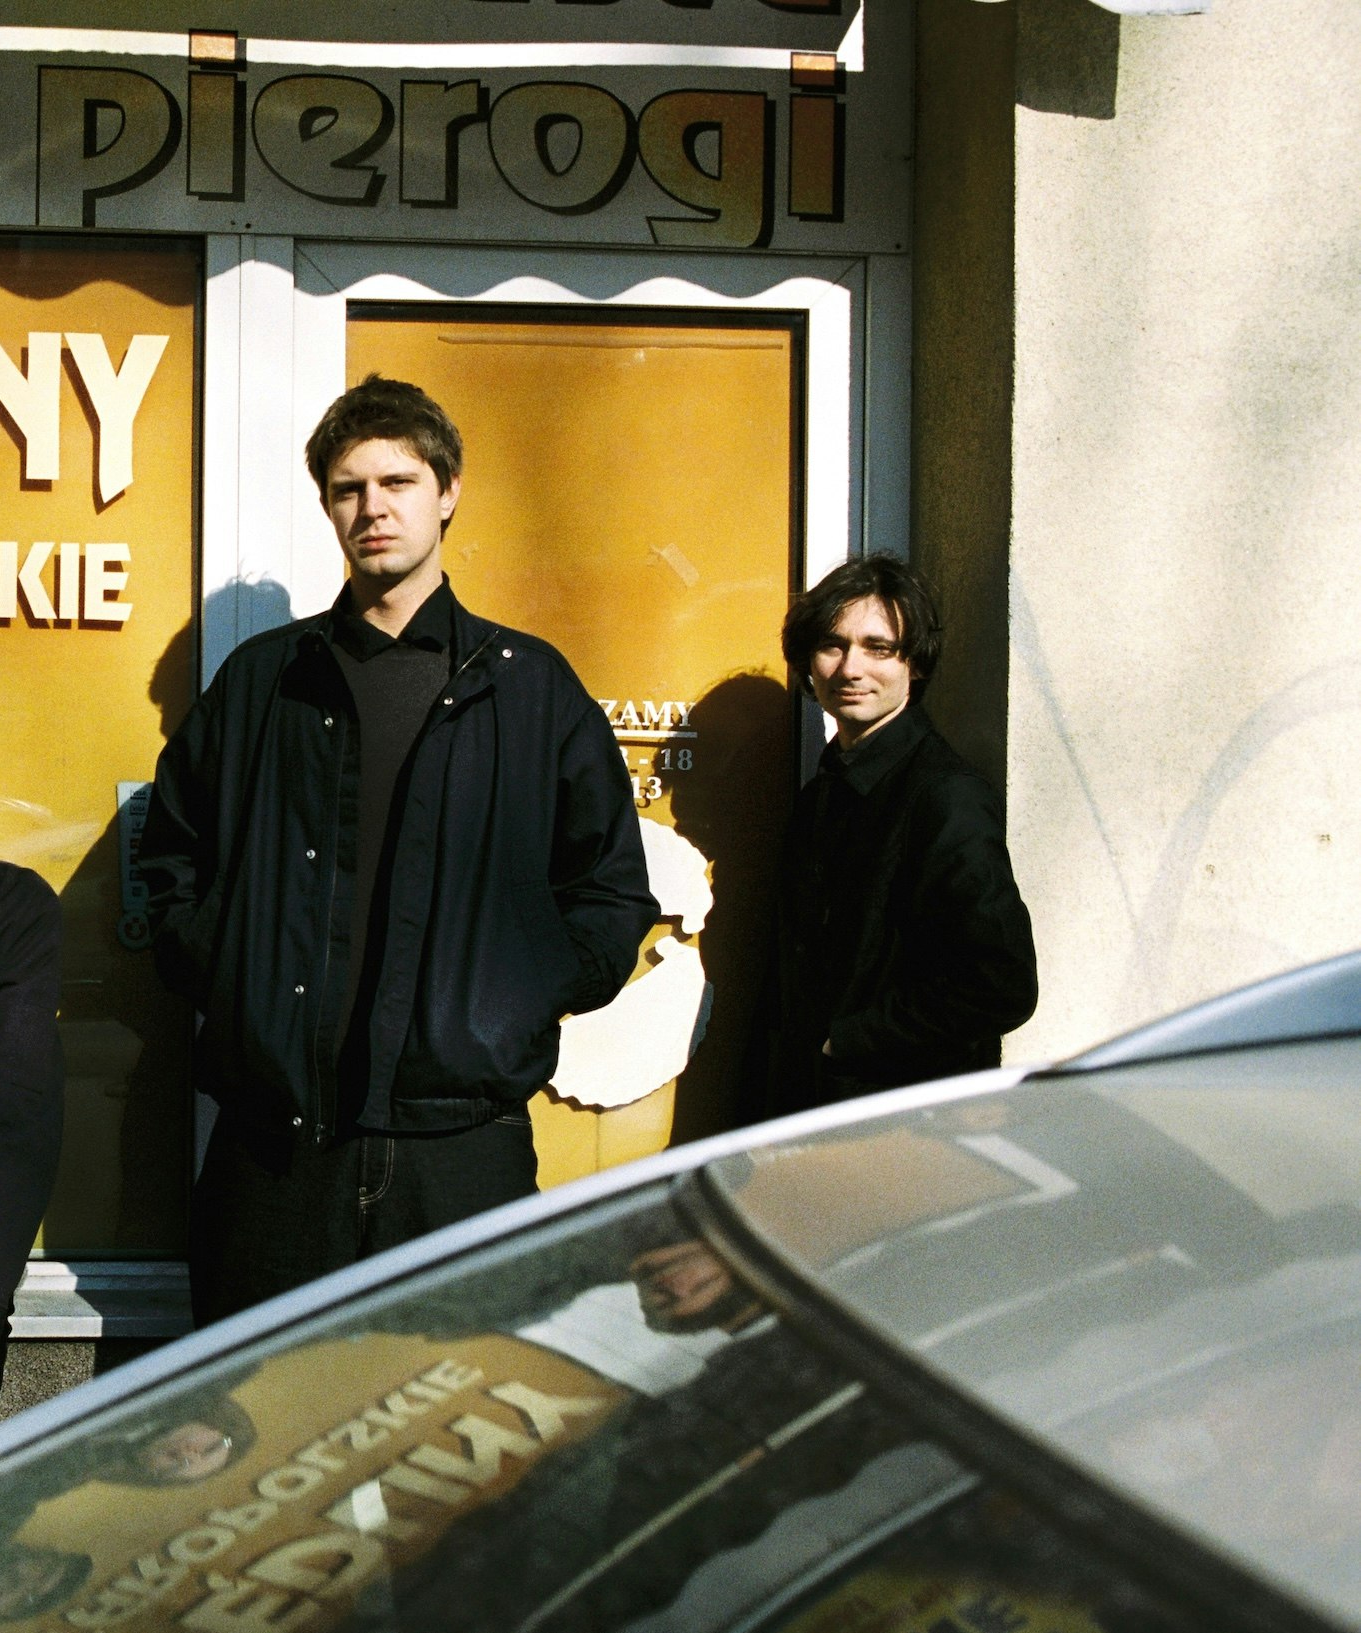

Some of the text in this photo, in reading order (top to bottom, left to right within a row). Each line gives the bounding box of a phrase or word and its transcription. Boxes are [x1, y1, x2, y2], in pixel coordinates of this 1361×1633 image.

[35, 29, 846, 249] pierogi
[598, 699, 697, 727] ZAMY
[661, 748, 693, 771] 18
